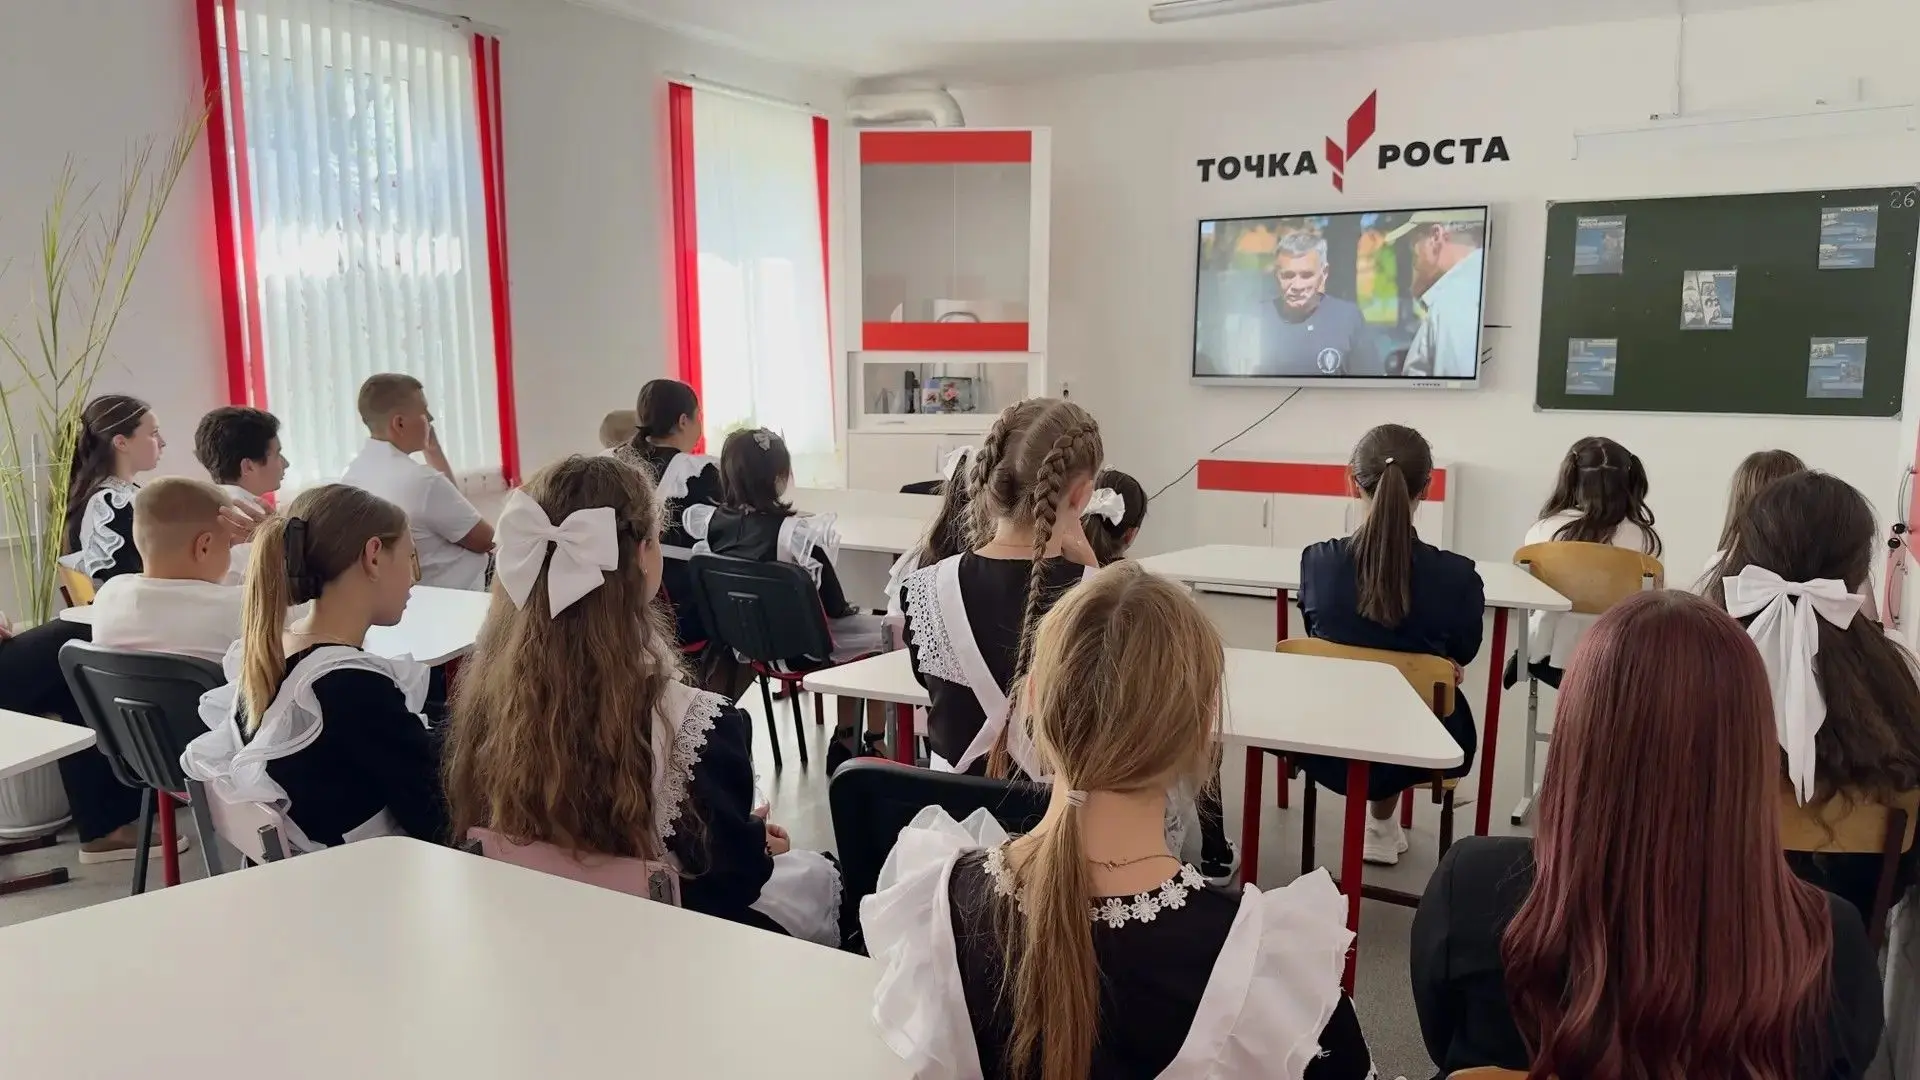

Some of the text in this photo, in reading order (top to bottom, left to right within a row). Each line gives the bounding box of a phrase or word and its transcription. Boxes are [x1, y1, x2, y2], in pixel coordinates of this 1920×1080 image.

[1196, 136, 1510, 183] ТОЧКА РОСТА
[1889, 190, 1916, 209] 26
